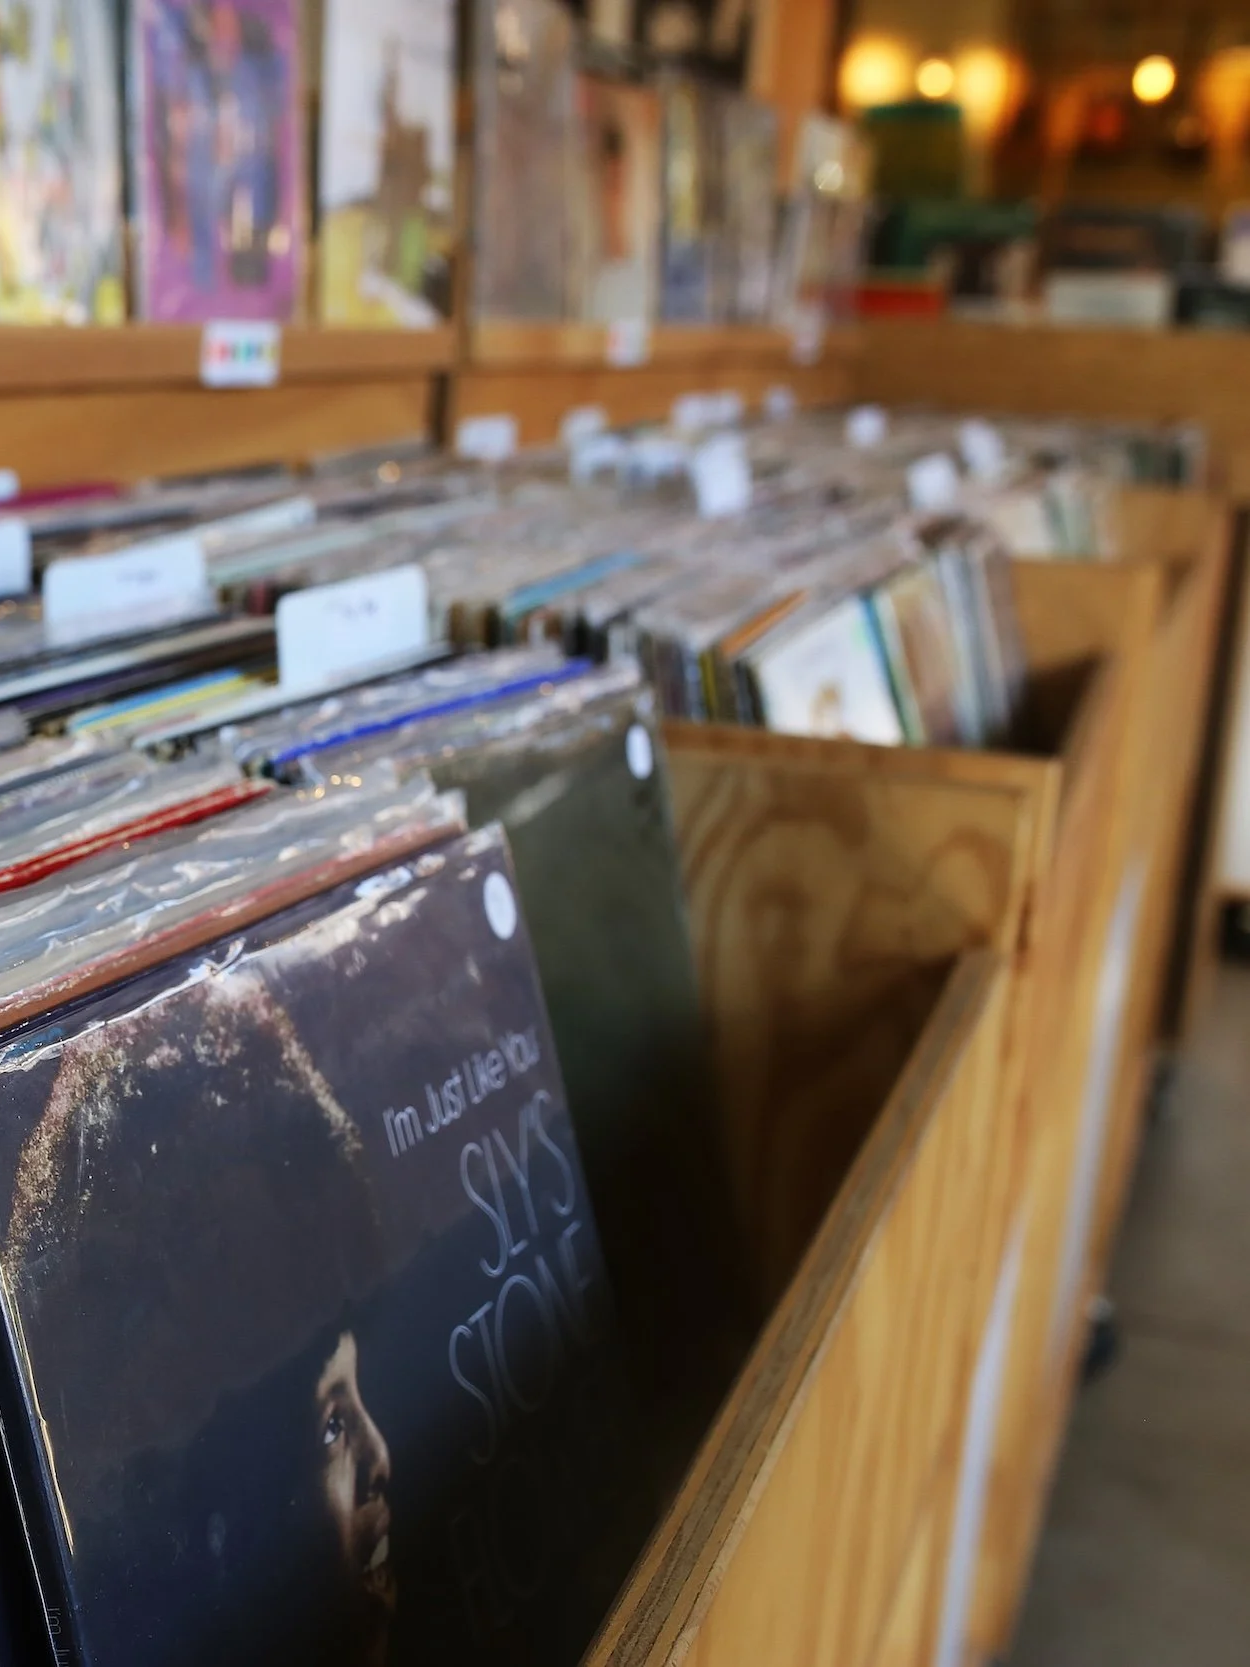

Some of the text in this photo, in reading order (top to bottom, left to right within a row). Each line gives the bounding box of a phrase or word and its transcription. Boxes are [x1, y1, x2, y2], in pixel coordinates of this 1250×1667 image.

[382, 1024, 541, 1158] I'm Just Like You
[448, 1219, 596, 1467] STONE
